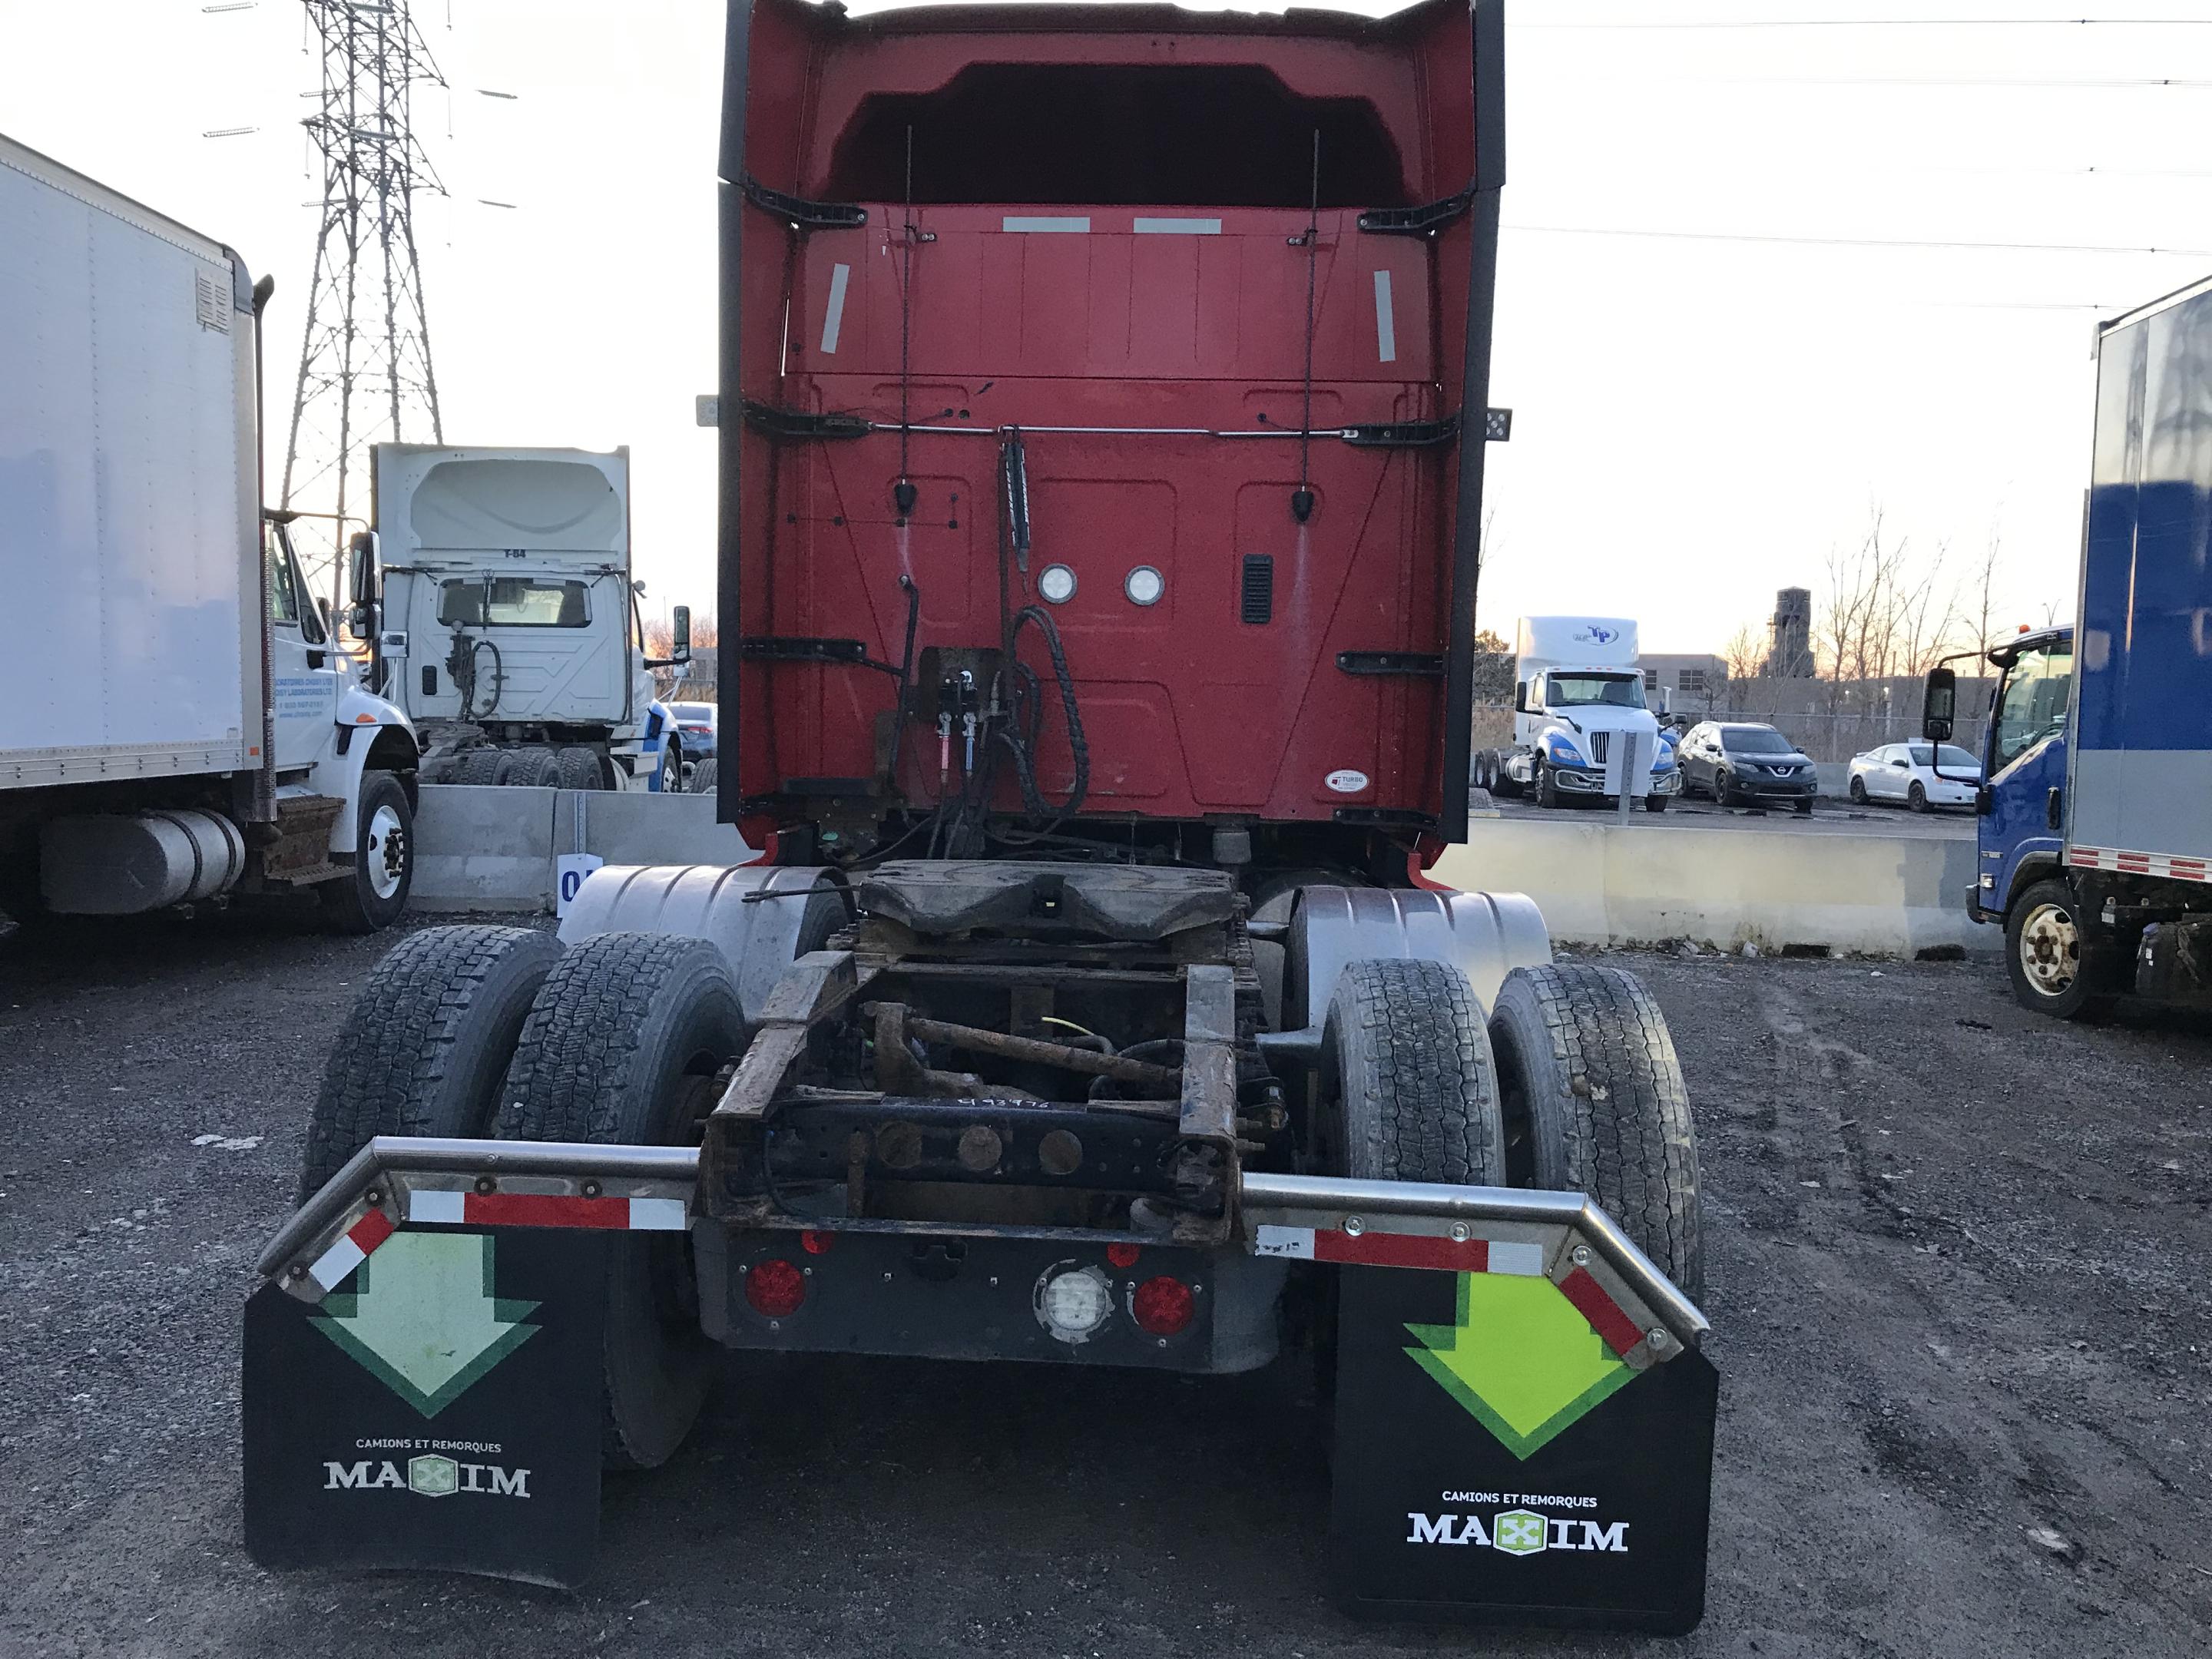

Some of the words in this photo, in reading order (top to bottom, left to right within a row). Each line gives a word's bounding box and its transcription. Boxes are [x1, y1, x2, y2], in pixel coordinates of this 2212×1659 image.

[356, 1438, 412, 1449] CAMIONS
[415, 1439, 429, 1449] ET
[432, 1439, 502, 1453] REMORQUES
[323, 1458, 531, 1498] MAXIM
[1442, 1491, 1500, 1503] CAMIONS
[1503, 1493, 1519, 1504] ET
[1522, 1494, 1598, 1508] REMORQUES
[1406, 1511, 1630, 1553] MAXIM
